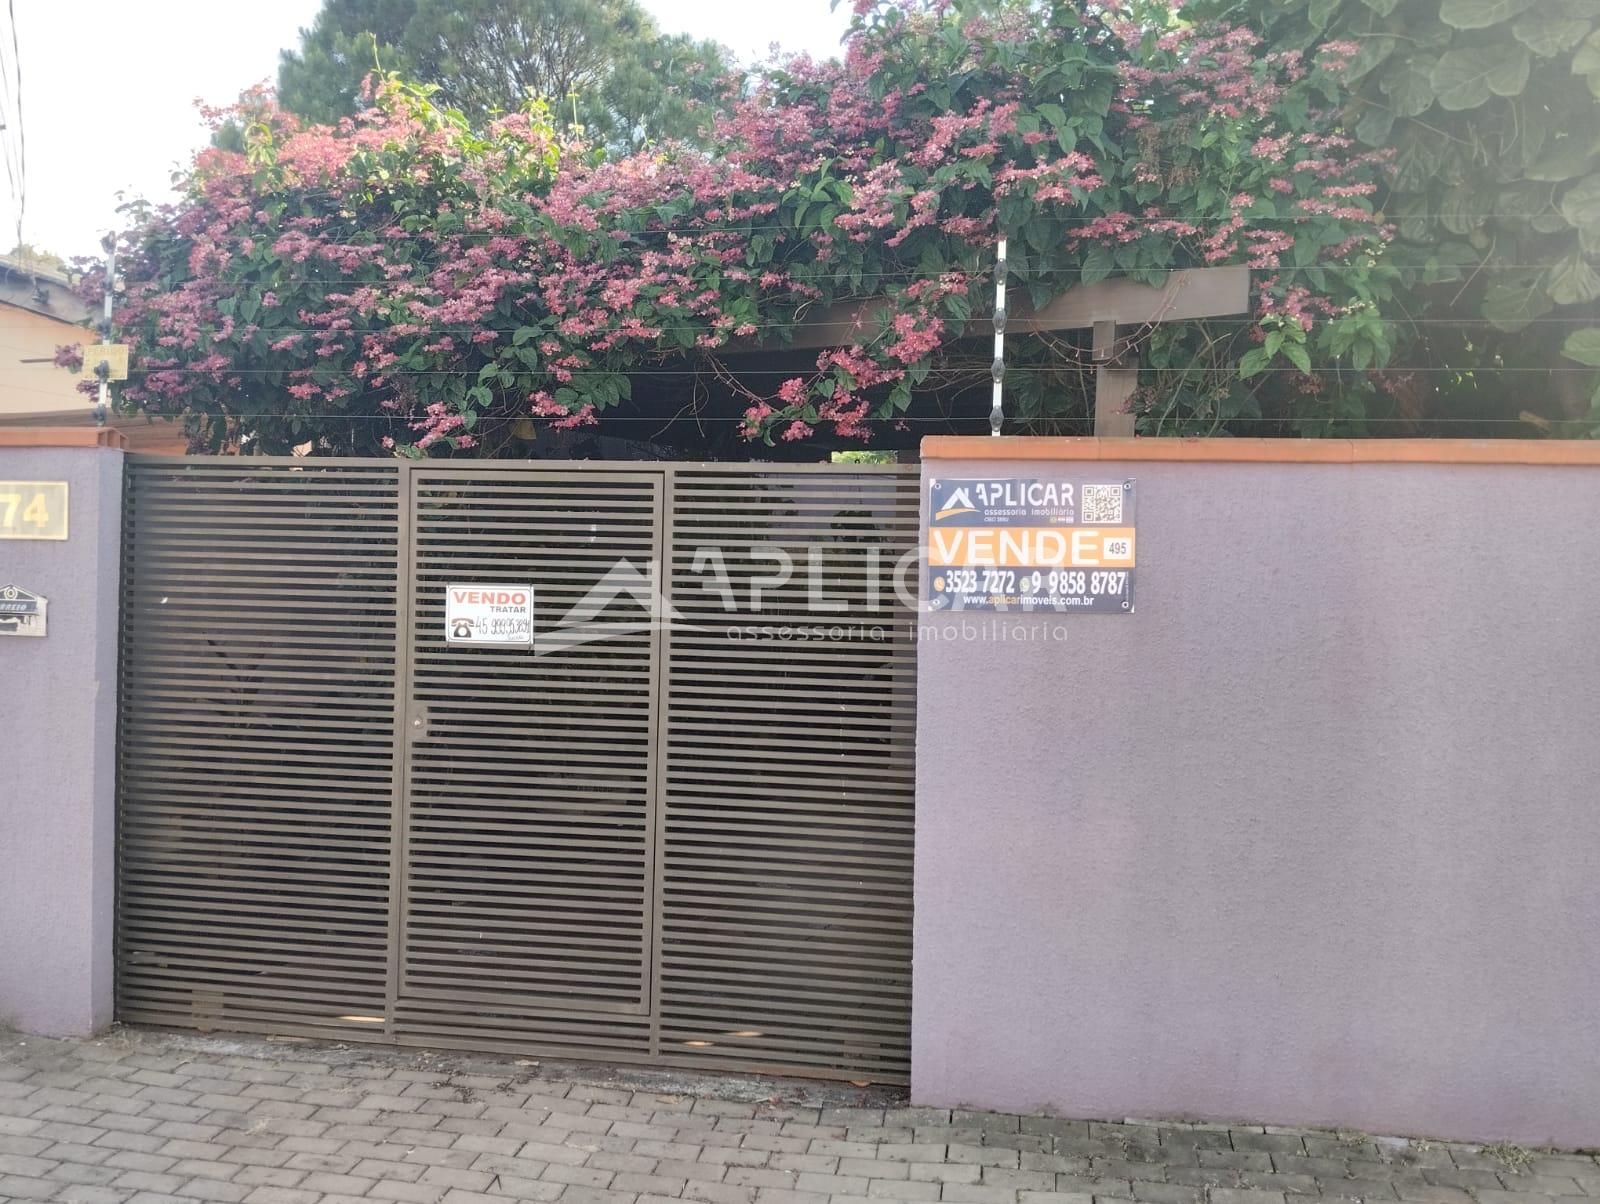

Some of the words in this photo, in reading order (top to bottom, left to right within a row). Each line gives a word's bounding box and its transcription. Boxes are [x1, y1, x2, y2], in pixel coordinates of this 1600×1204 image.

[976, 483, 1075, 506] APLICAR
[933, 530, 1100, 565] VENDE
[1108, 542, 1127, 555] 495
[945, 571, 978, 594] 3523
[982, 571, 1015, 594] 7272
[1032, 571, 1042, 594] 9
[1049, 571, 1086, 595] 9858
[1090, 571, 1126, 595] 8787
[453, 591, 527, 605] VENDO
[963, 595, 1095, 606] www.aplicarimoveis.com.br
[490, 605, 527, 613] TRATAR
